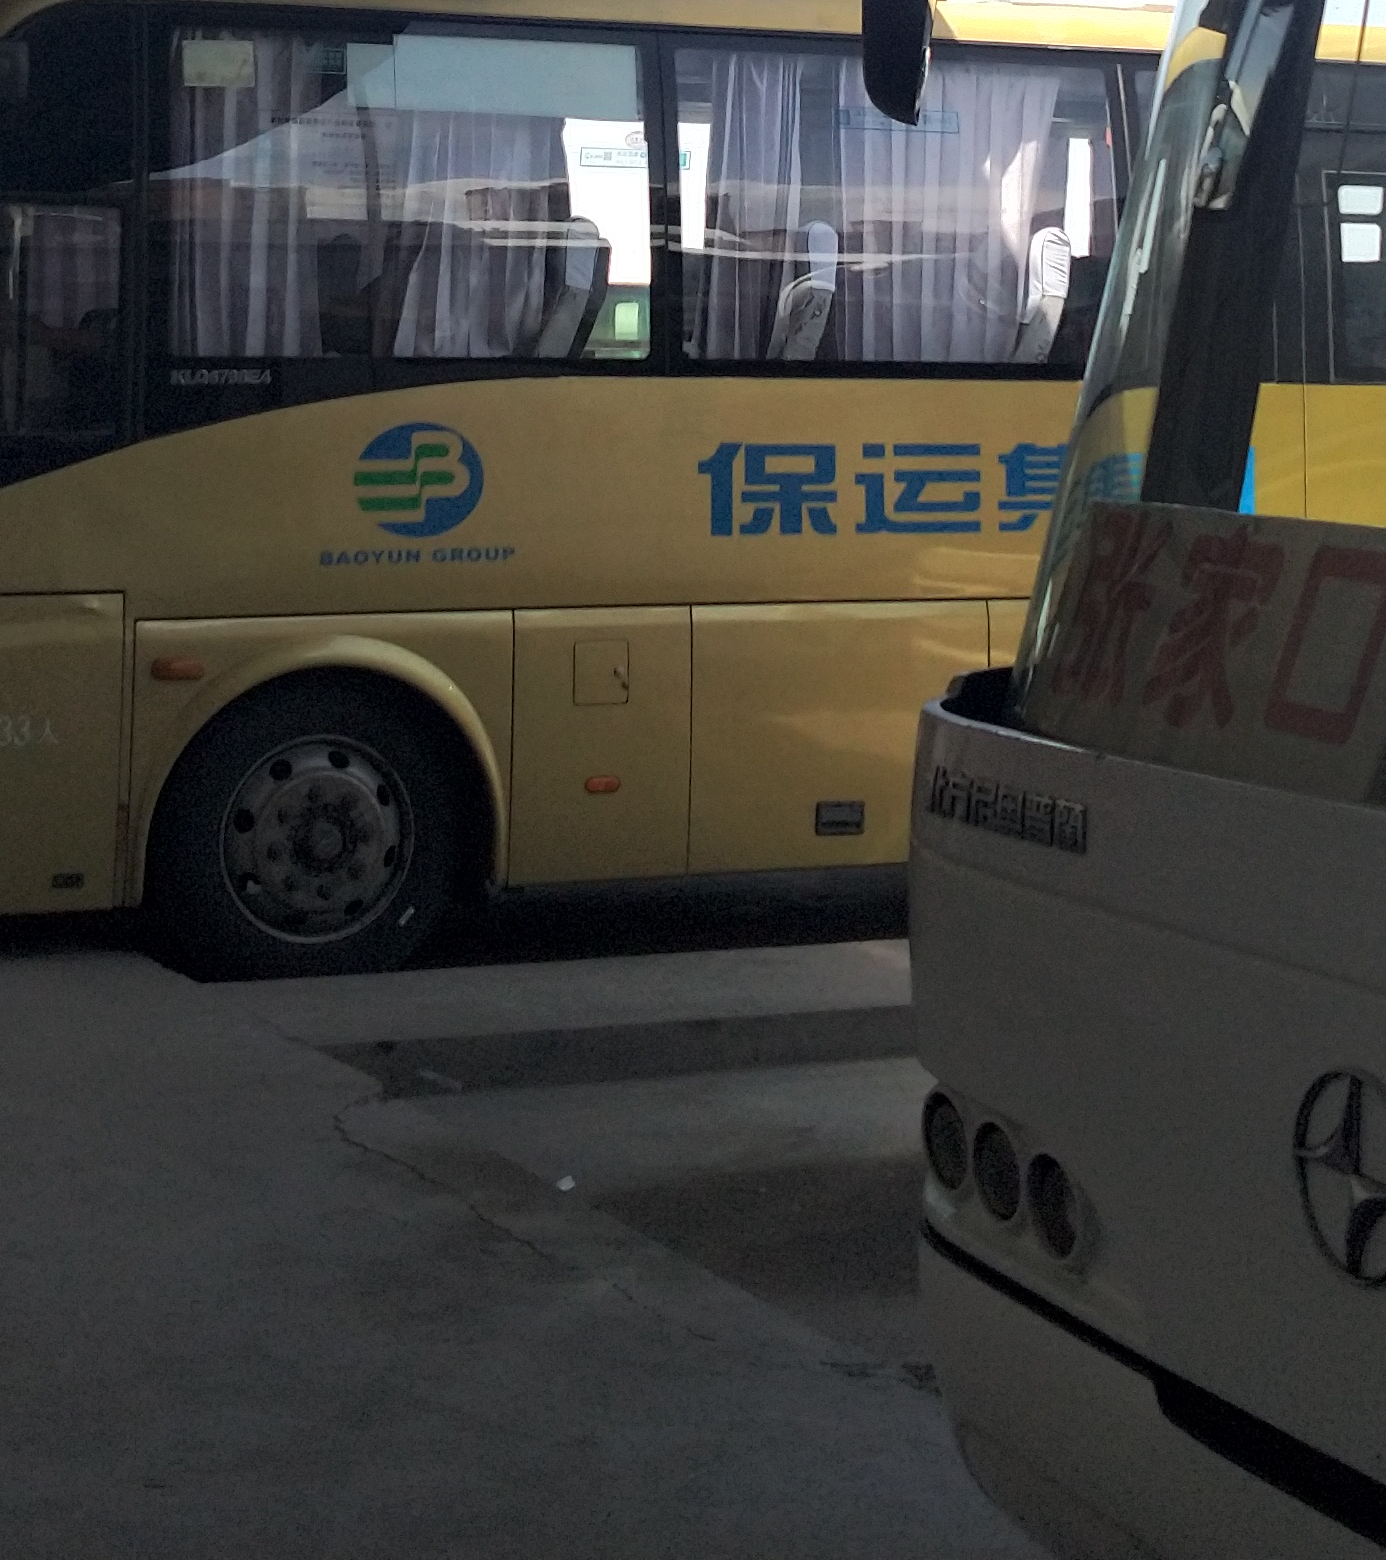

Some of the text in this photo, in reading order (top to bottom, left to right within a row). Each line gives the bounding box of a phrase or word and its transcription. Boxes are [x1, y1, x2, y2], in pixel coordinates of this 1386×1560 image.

[698, 441, 1143, 537] 保运集
[320, 546, 515, 567] BAOYUN GROUP
